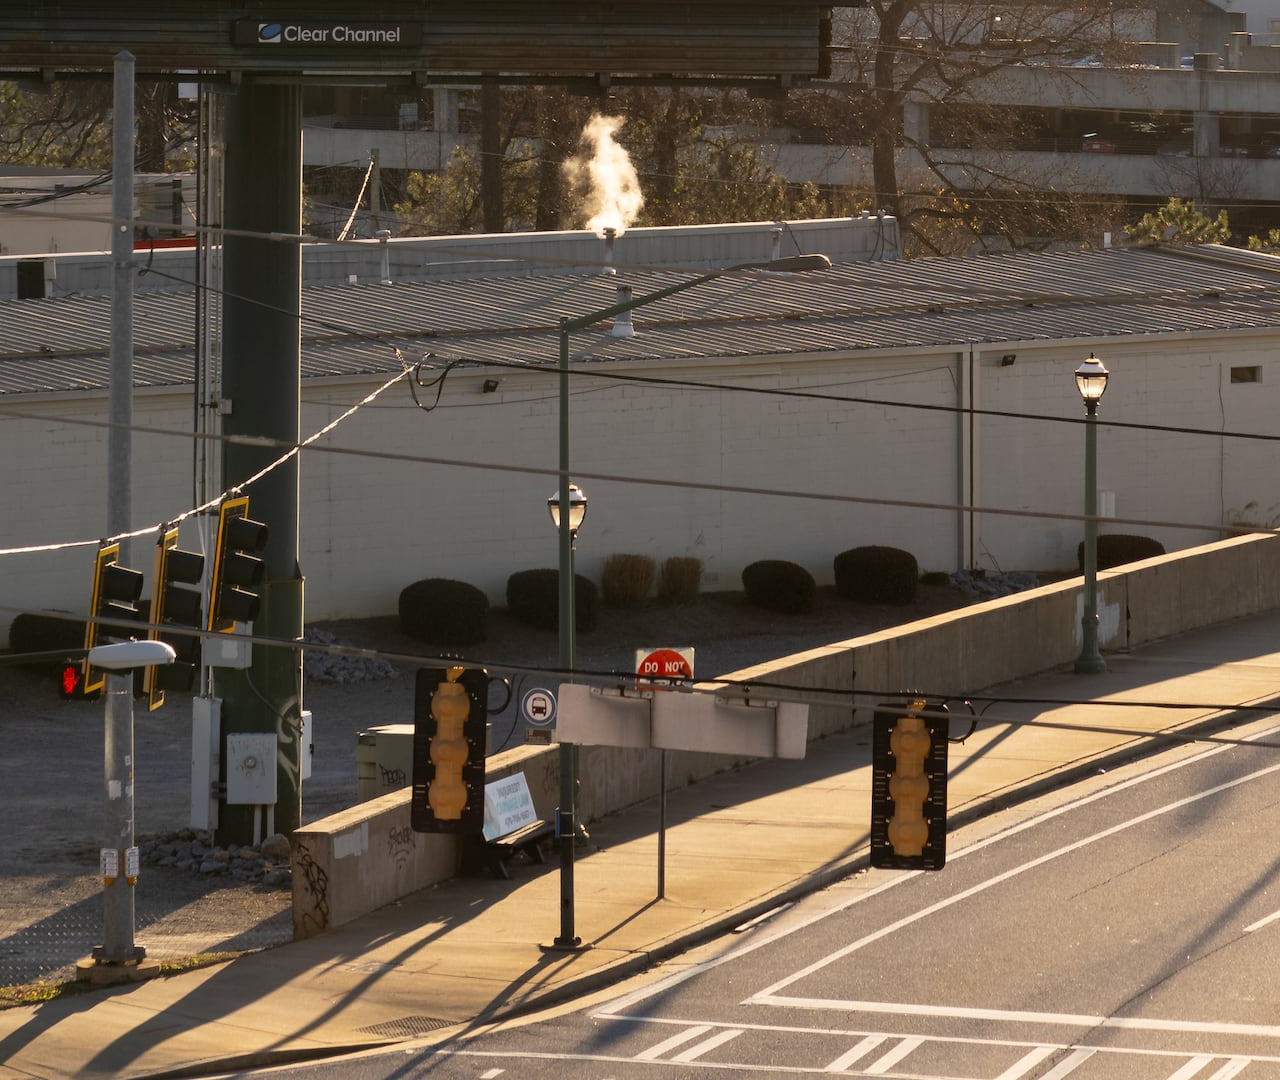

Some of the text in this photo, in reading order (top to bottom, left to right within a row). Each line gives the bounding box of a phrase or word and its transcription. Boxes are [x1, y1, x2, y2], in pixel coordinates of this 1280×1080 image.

[284, 26, 400, 42] Clear Channel
[644, 661, 685, 673] DO NOT
